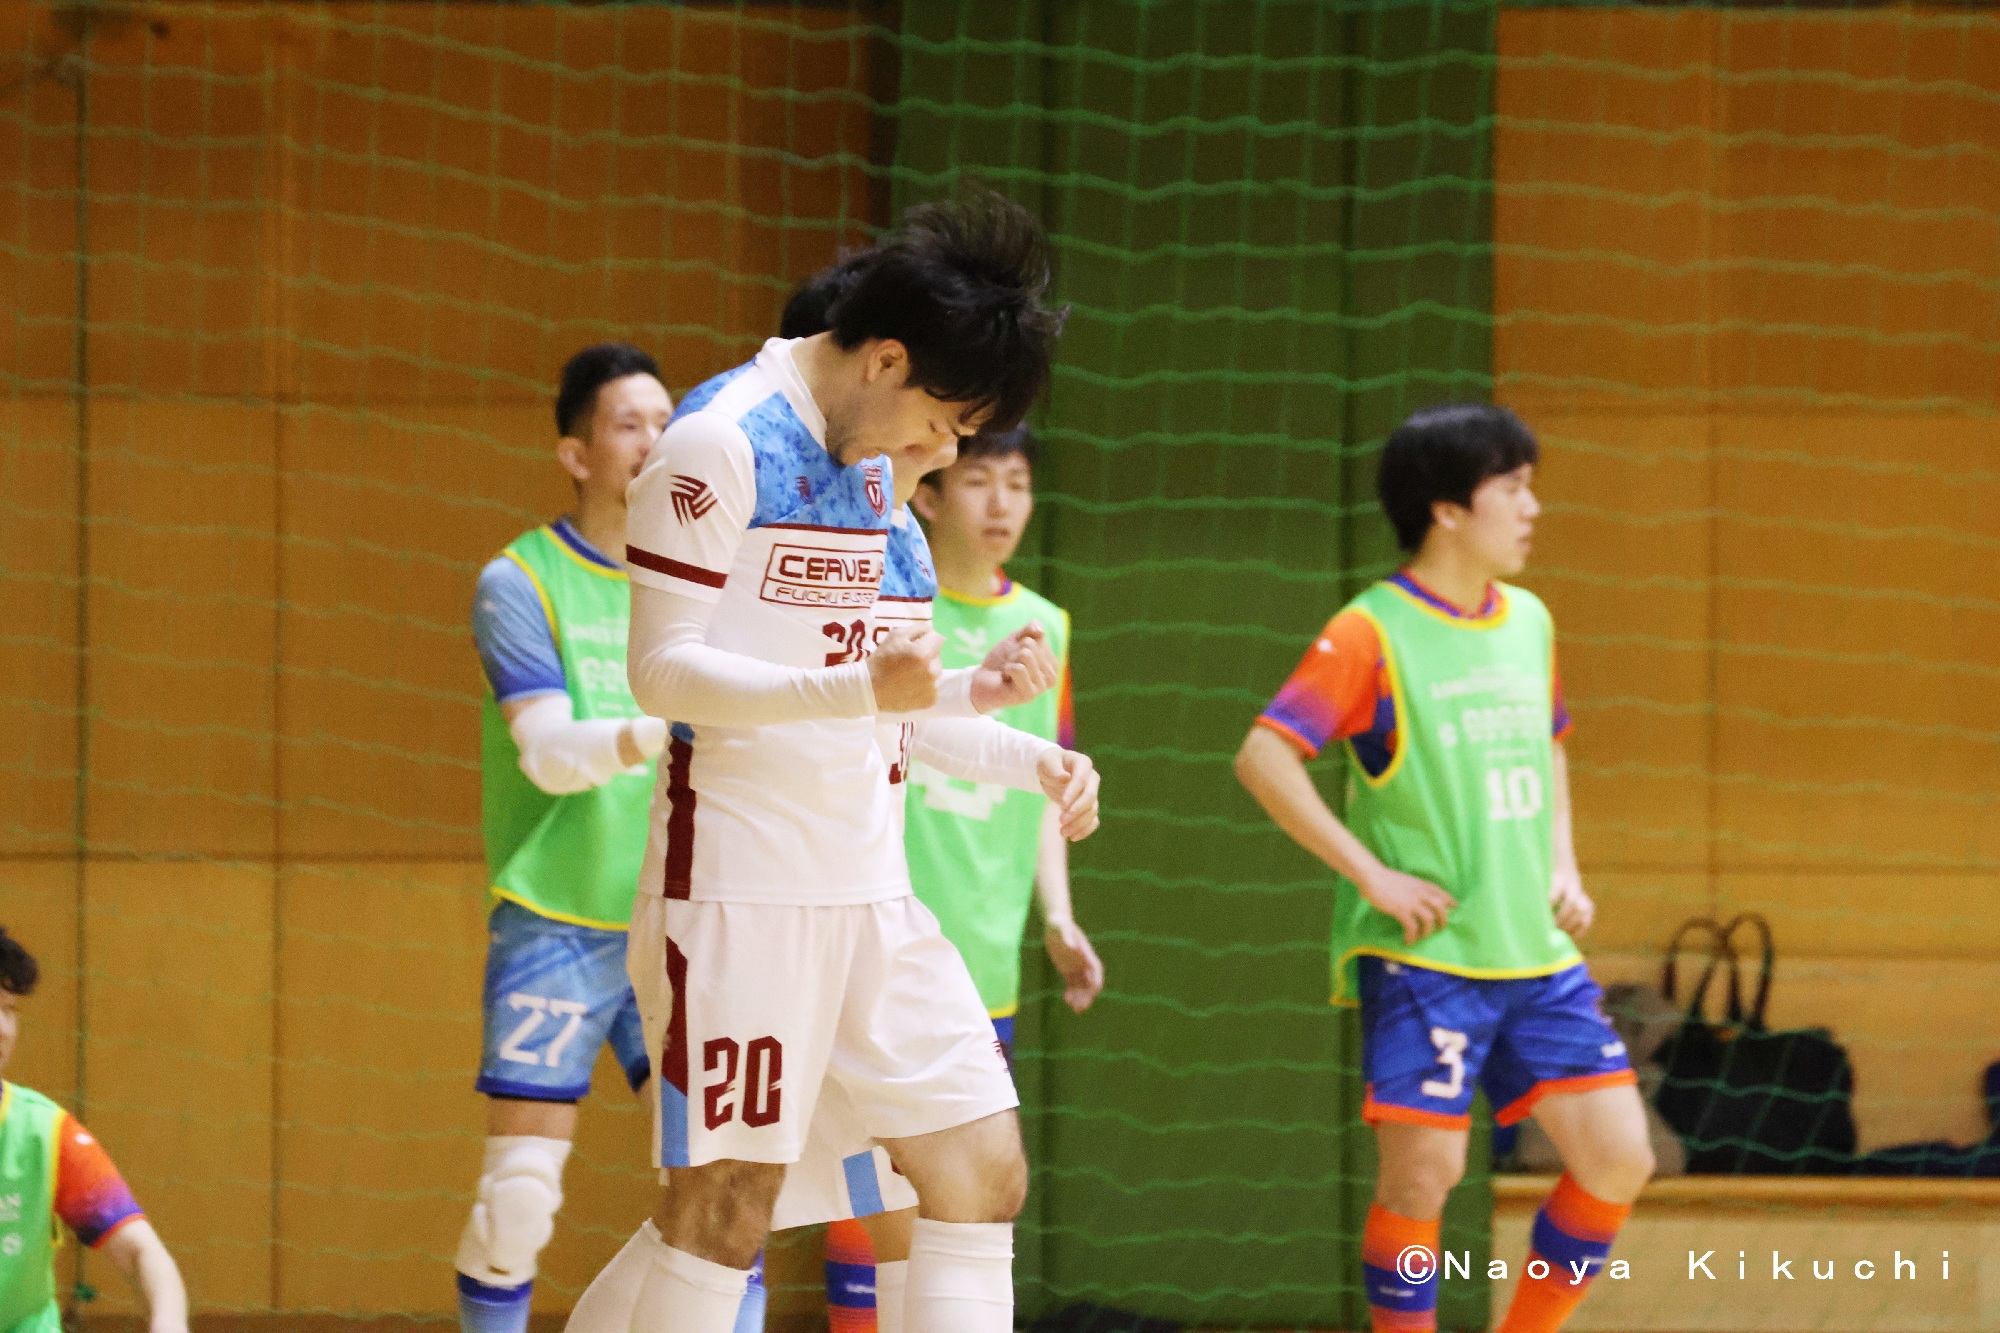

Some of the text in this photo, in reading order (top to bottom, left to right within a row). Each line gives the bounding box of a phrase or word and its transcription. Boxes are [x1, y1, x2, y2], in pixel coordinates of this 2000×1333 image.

[1487, 766, 1541, 821] 10
[499, 992, 588, 1068] 27
[1421, 1027, 1467, 1099] 3
[703, 1036, 783, 1131] 20
